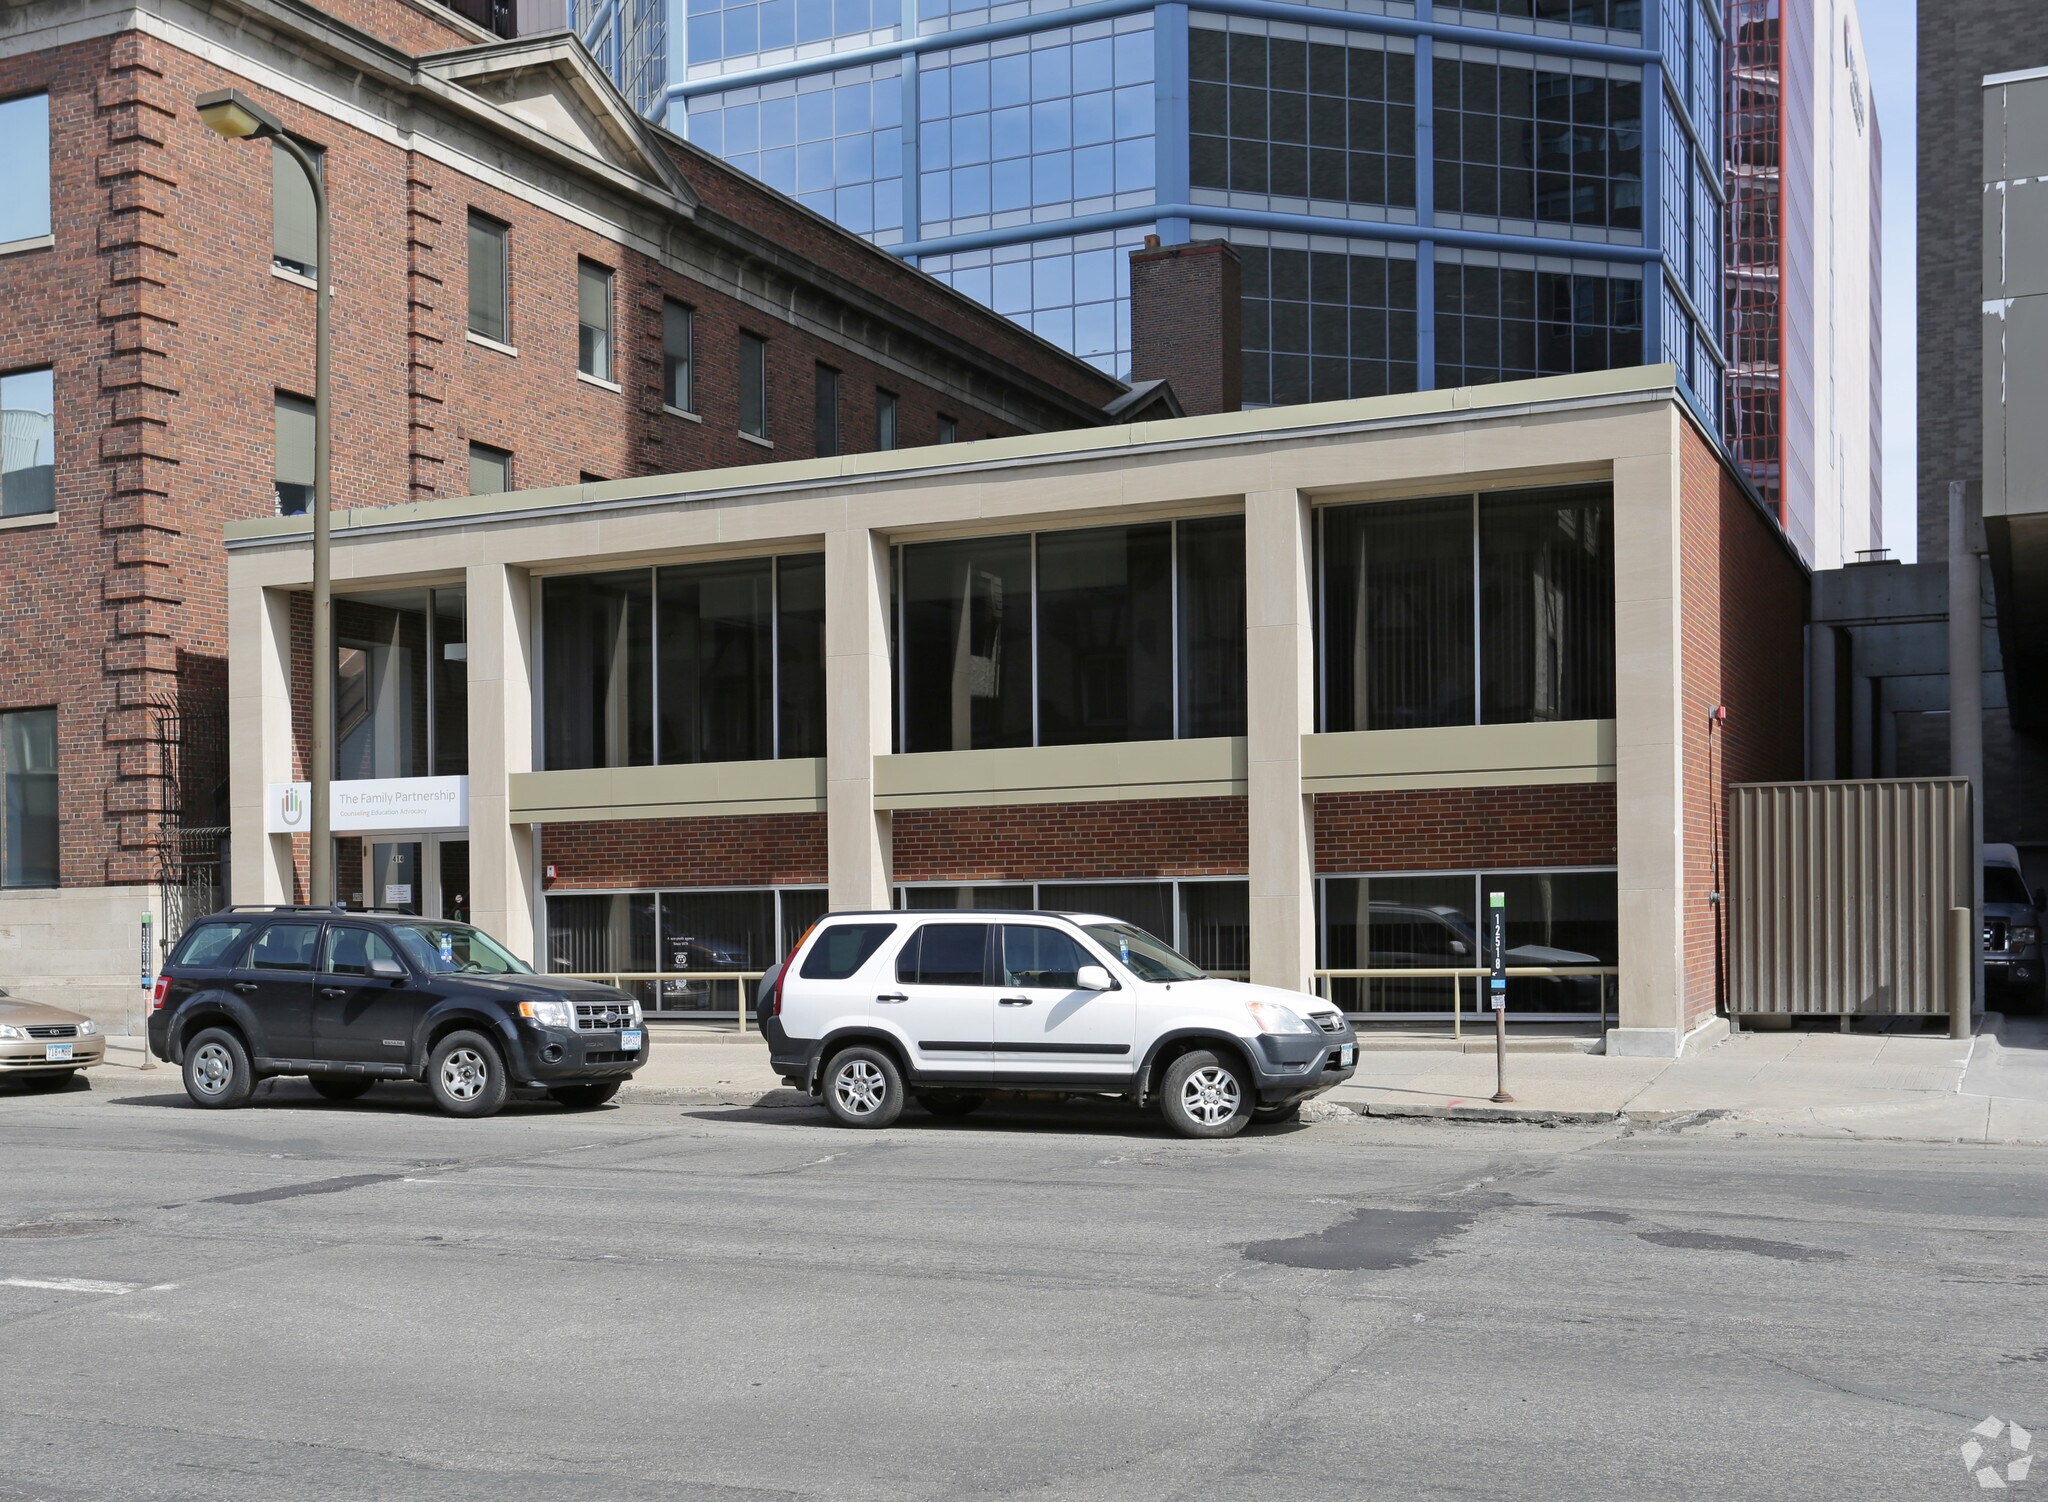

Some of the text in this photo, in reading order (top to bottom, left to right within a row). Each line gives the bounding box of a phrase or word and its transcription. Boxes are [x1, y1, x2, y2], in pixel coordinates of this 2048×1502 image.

[339, 789, 456, 805] The Family Partnership
[400, 807, 427, 815] Advocacy
[392, 855, 404, 863] 414
